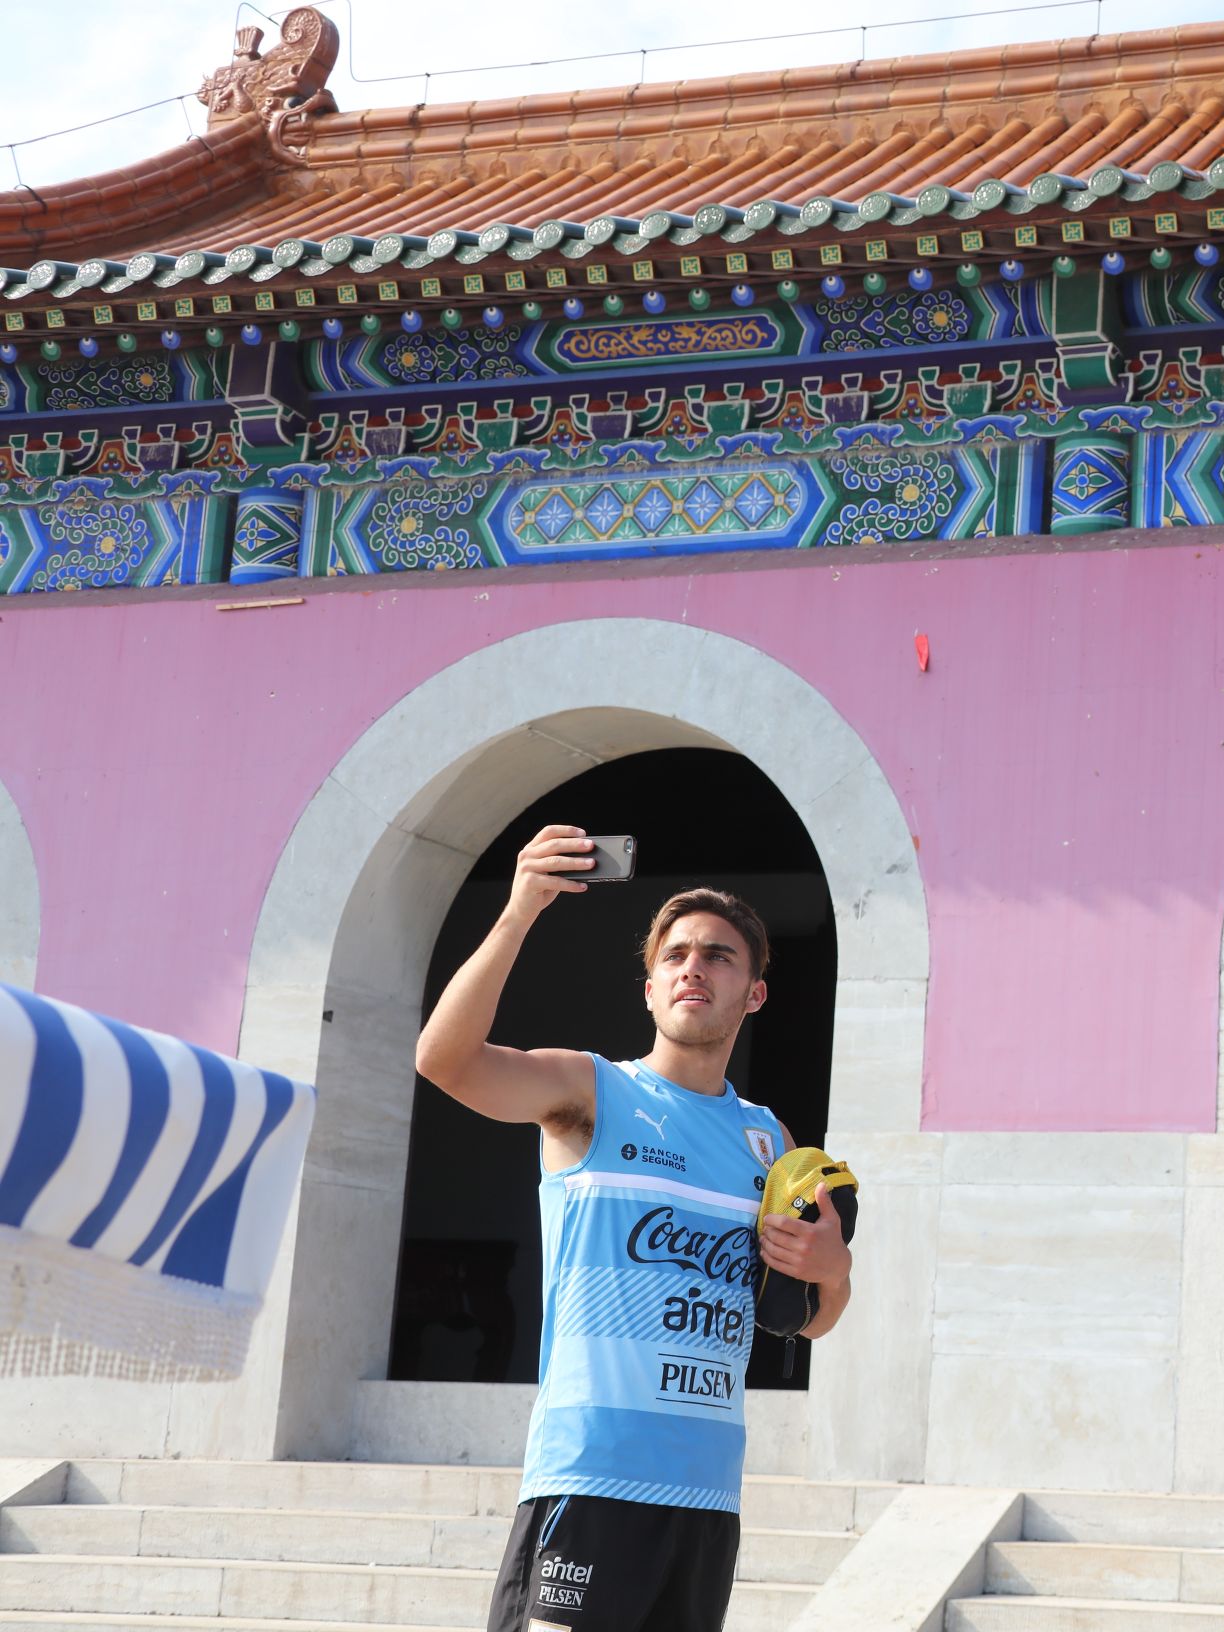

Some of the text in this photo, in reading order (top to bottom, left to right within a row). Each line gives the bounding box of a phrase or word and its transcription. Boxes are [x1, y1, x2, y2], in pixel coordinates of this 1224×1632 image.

[641, 1154, 687, 1173] SEGUROS
[642, 1145, 686, 1164] SANCOR
[662, 1287, 745, 1347] antel
[660, 1363, 736, 1400] PILSEN
[541, 1556, 593, 1584] antel
[539, 1585, 584, 1607] PILSEN
